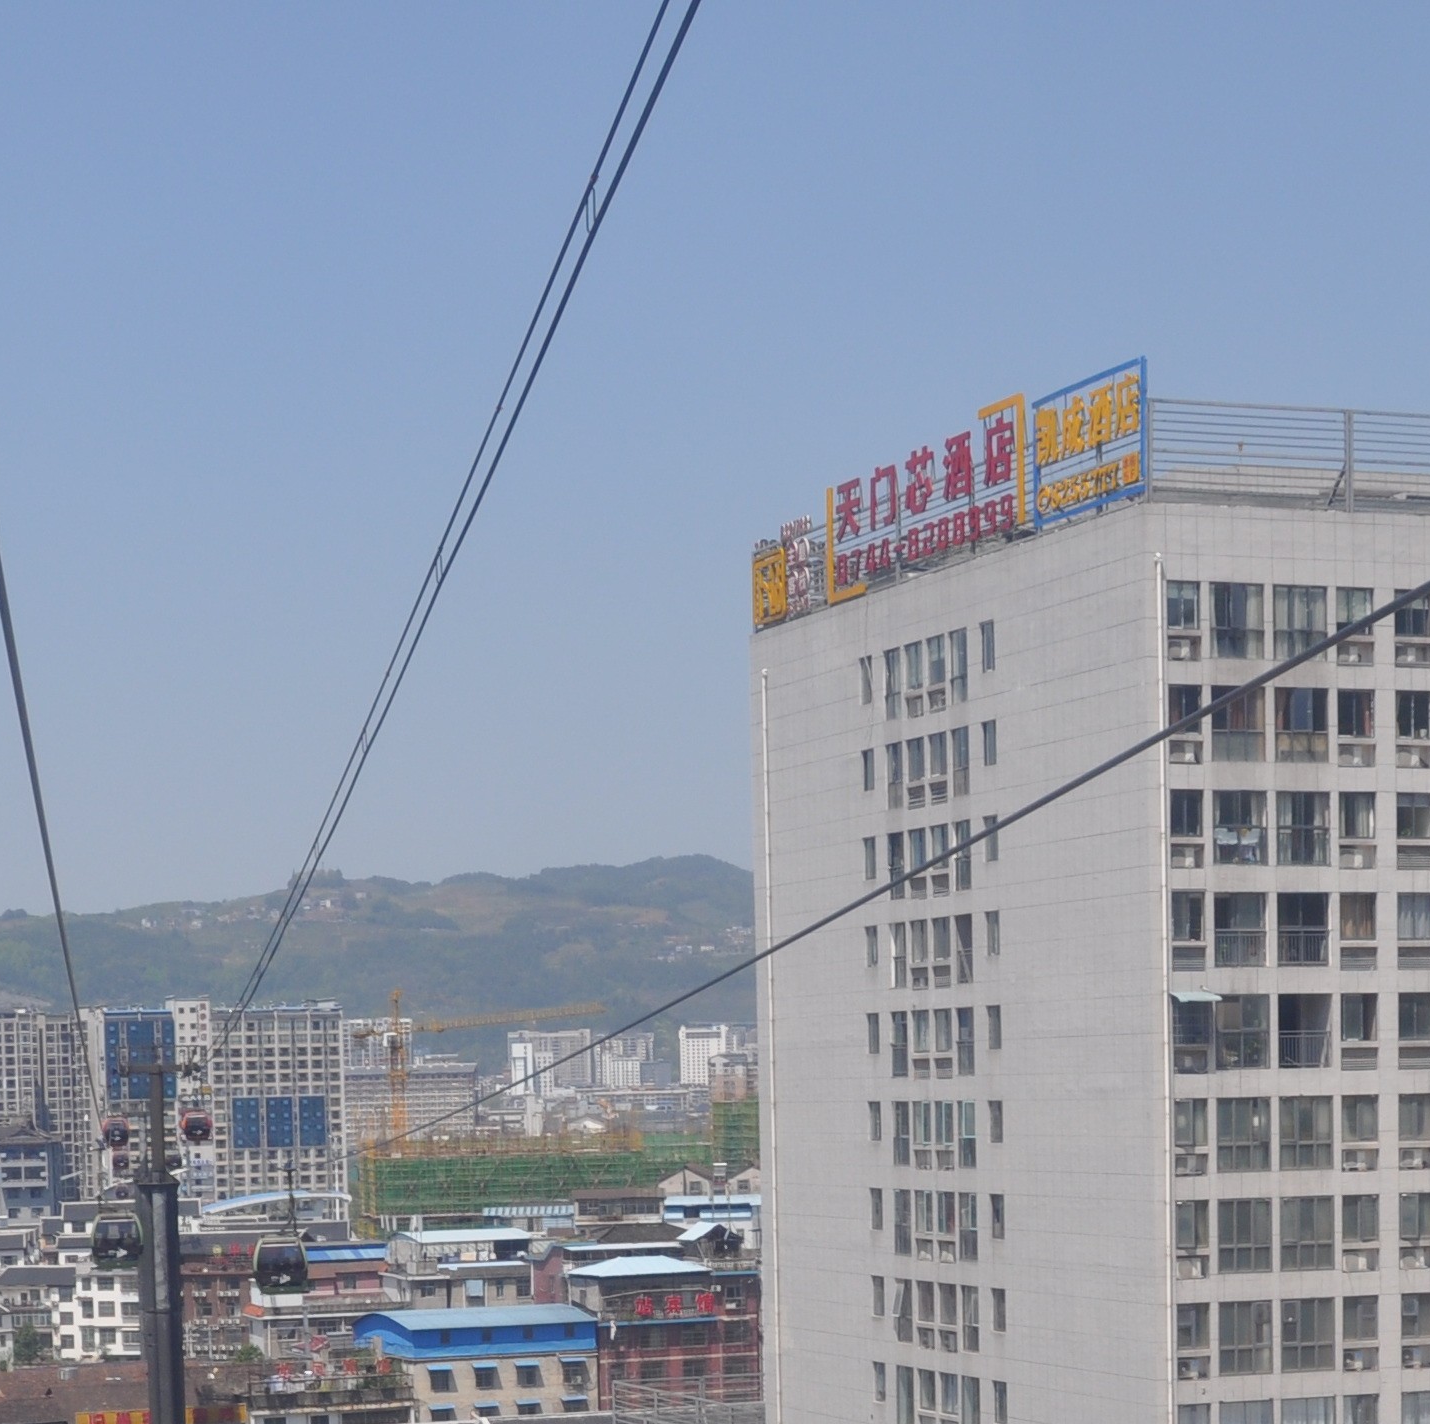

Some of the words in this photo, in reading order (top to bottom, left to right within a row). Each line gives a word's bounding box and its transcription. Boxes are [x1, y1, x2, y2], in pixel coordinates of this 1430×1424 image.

[835, 416, 1014, 543] 天门芯酒店
